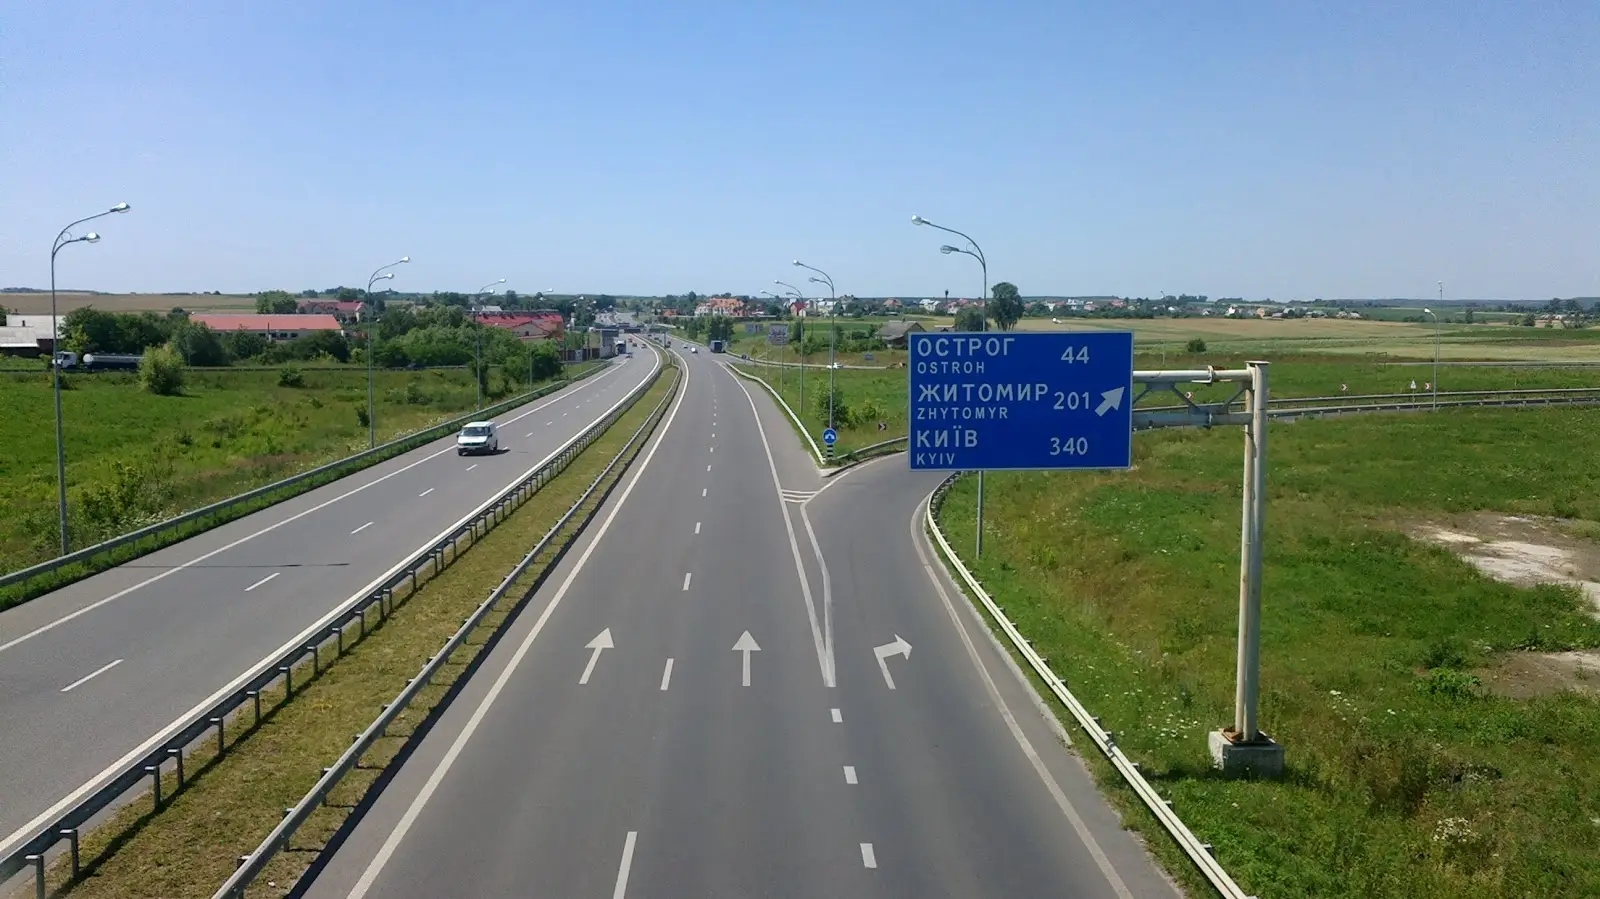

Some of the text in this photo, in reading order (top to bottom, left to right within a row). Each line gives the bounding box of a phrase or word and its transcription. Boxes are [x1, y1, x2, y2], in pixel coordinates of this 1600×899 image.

[917, 338, 1015, 357] ОСТРОГ
[1061, 346, 1090, 364] 44
[917, 361, 985, 374] OSTROH
[918, 383, 1049, 402] ЖИТОМИР
[1053, 391, 1090, 410] 201
[917, 407, 1008, 420] ZHYTOMYR
[916, 425, 978, 448] КИЇВ
[1049, 437, 1089, 456] 340
[916, 453, 955, 465] KYIV
